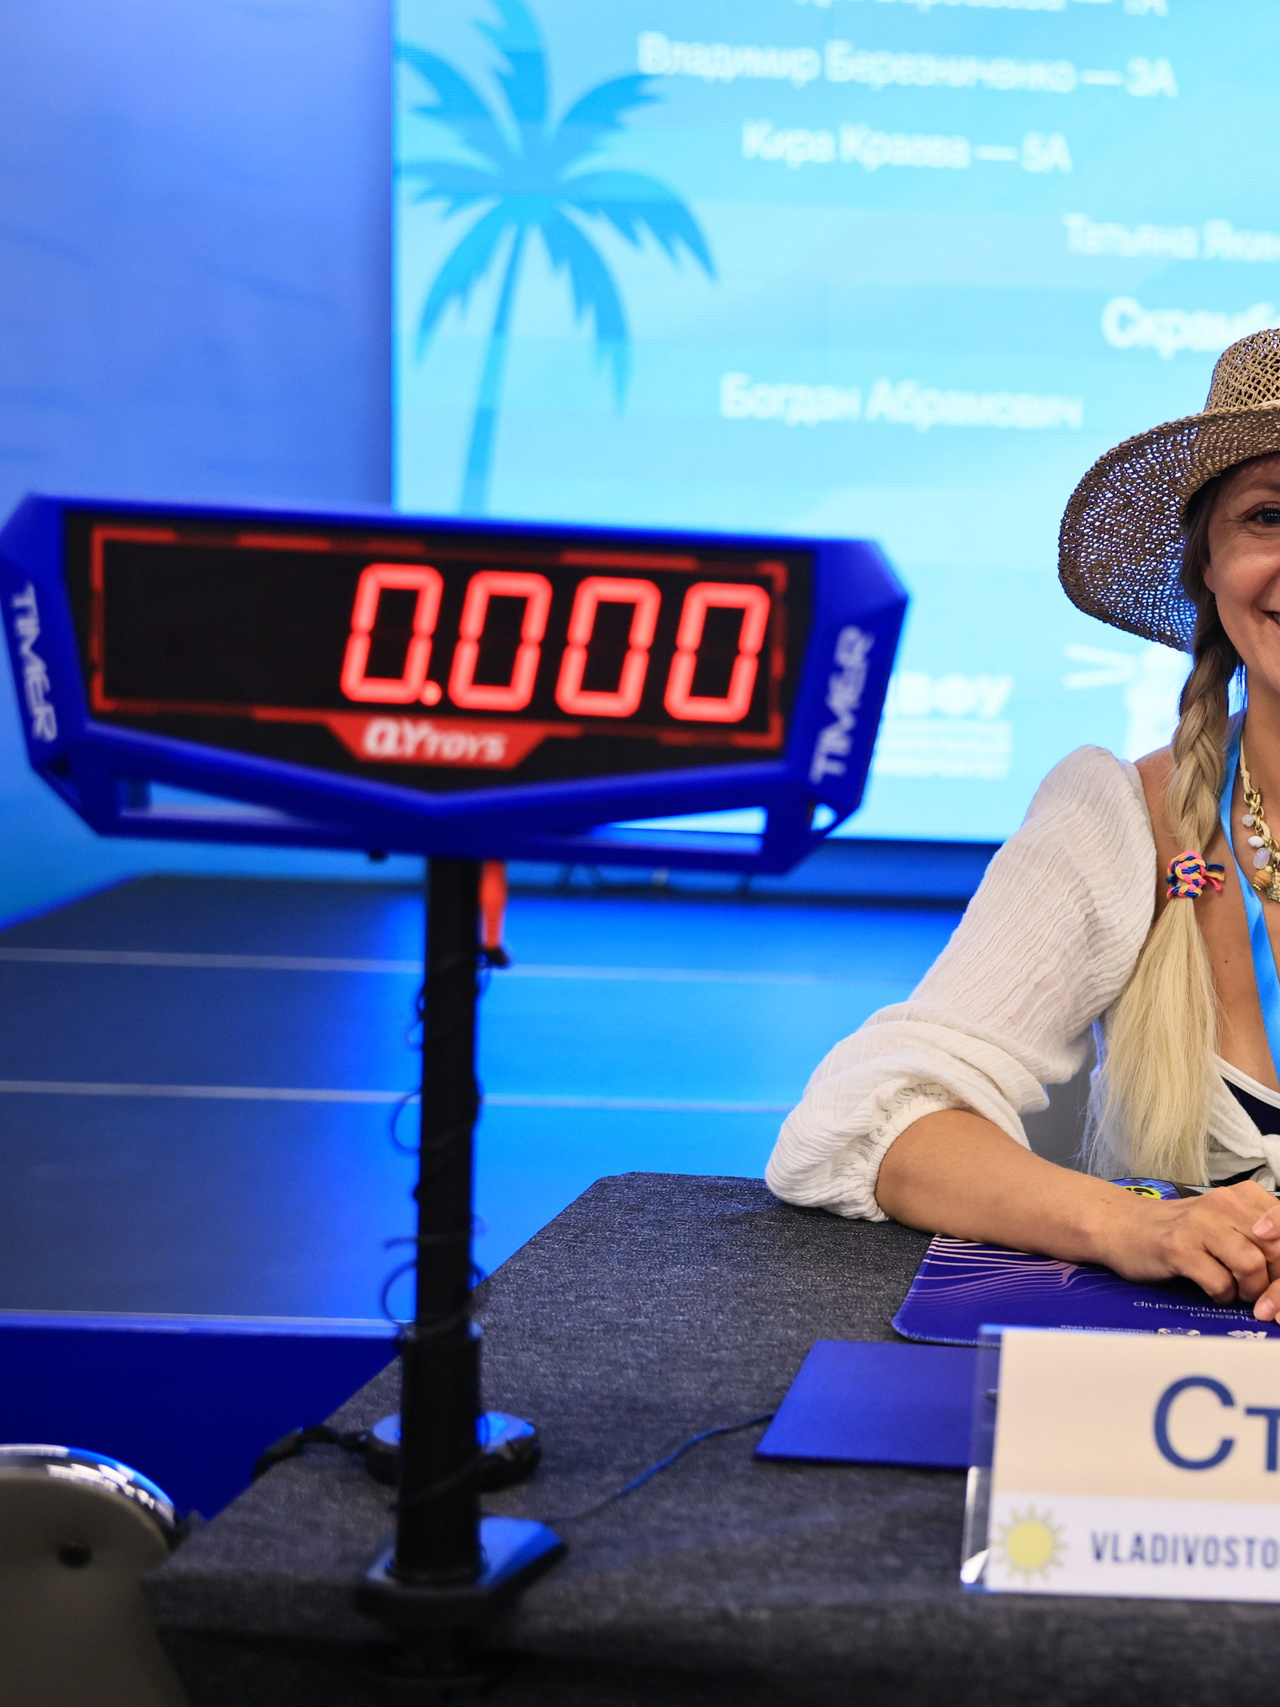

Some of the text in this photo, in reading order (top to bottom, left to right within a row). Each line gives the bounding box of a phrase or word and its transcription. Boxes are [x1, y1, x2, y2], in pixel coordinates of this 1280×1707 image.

[638, 32, 821, 87] Владимир
[743, 119, 836, 168] Кира
[1062, 212, 1199, 260] Татьяна
[720, 372, 861, 428] Богдан
[10, 580, 58, 744] TIMER
[339, 562, 772, 724] 0.000
[808, 624, 876, 785] TIMER
